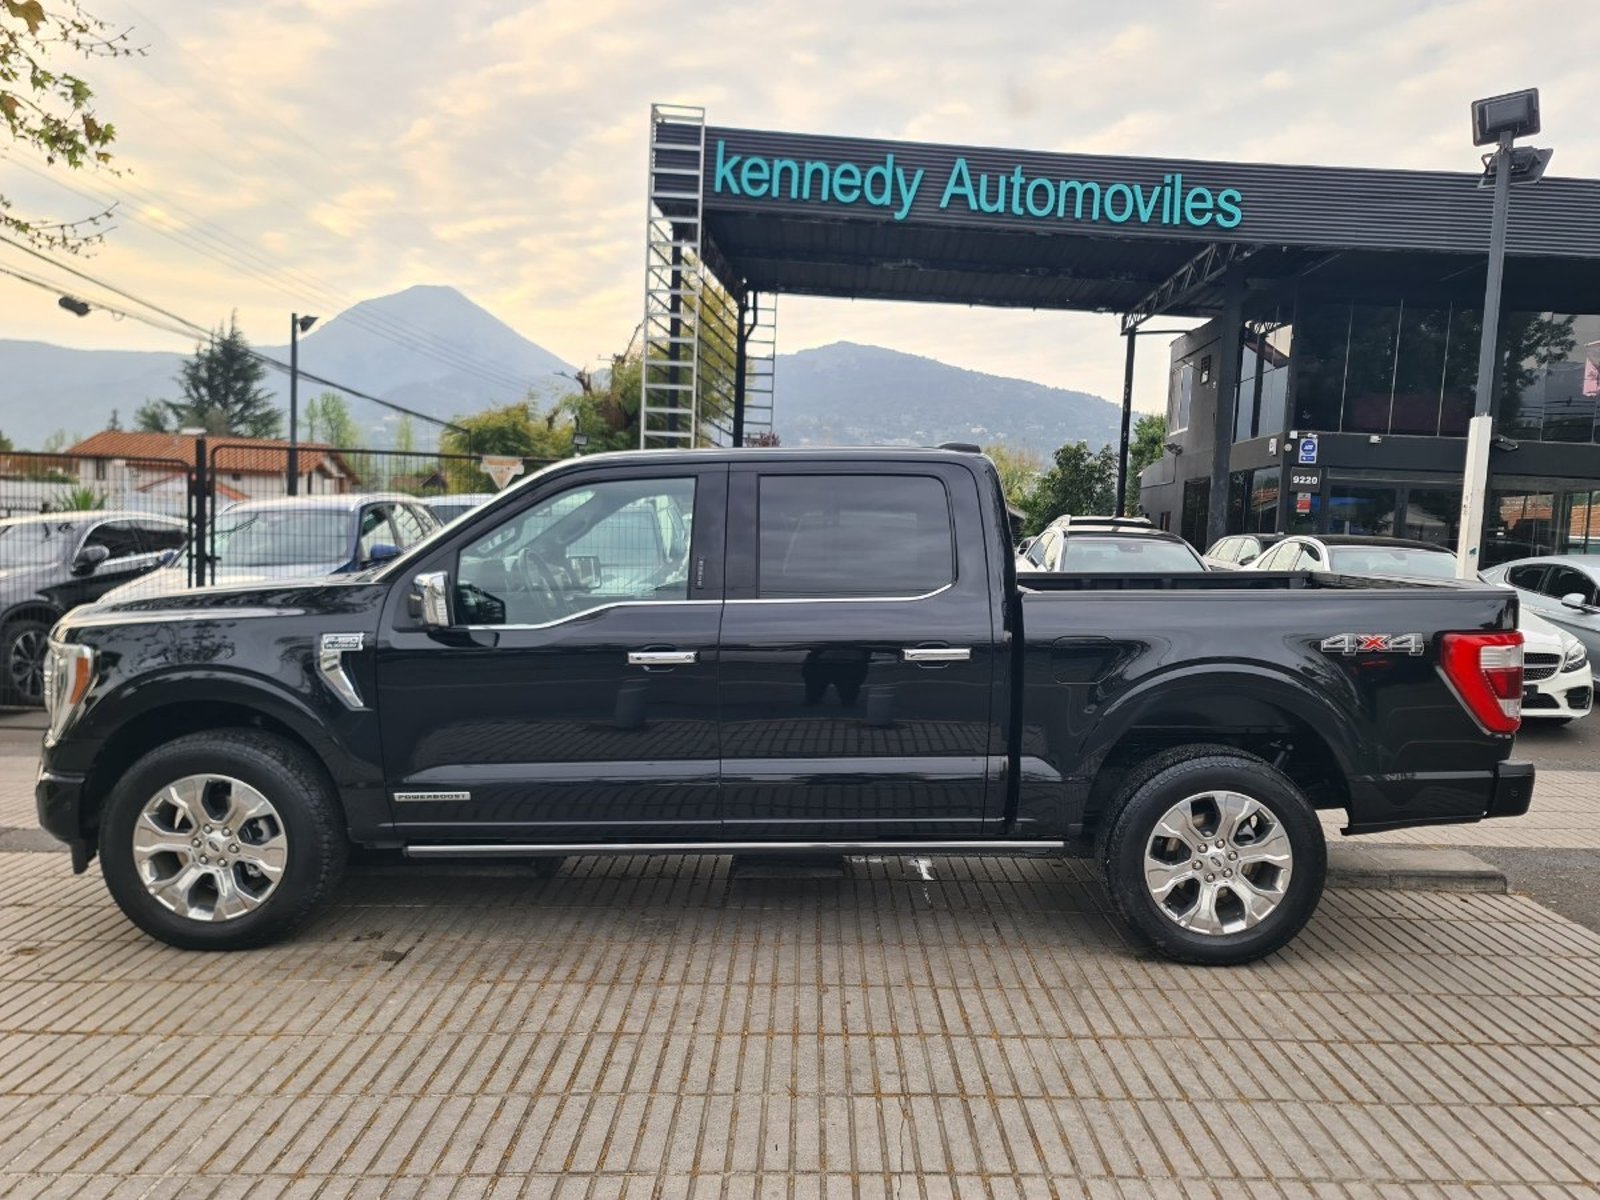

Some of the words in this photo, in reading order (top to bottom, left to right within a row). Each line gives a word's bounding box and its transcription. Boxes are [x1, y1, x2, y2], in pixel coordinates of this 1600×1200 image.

[714, 139, 924, 221] kennedy
[940, 157, 1243, 229] Automoviles
[1292, 475, 1318, 485] 9220
